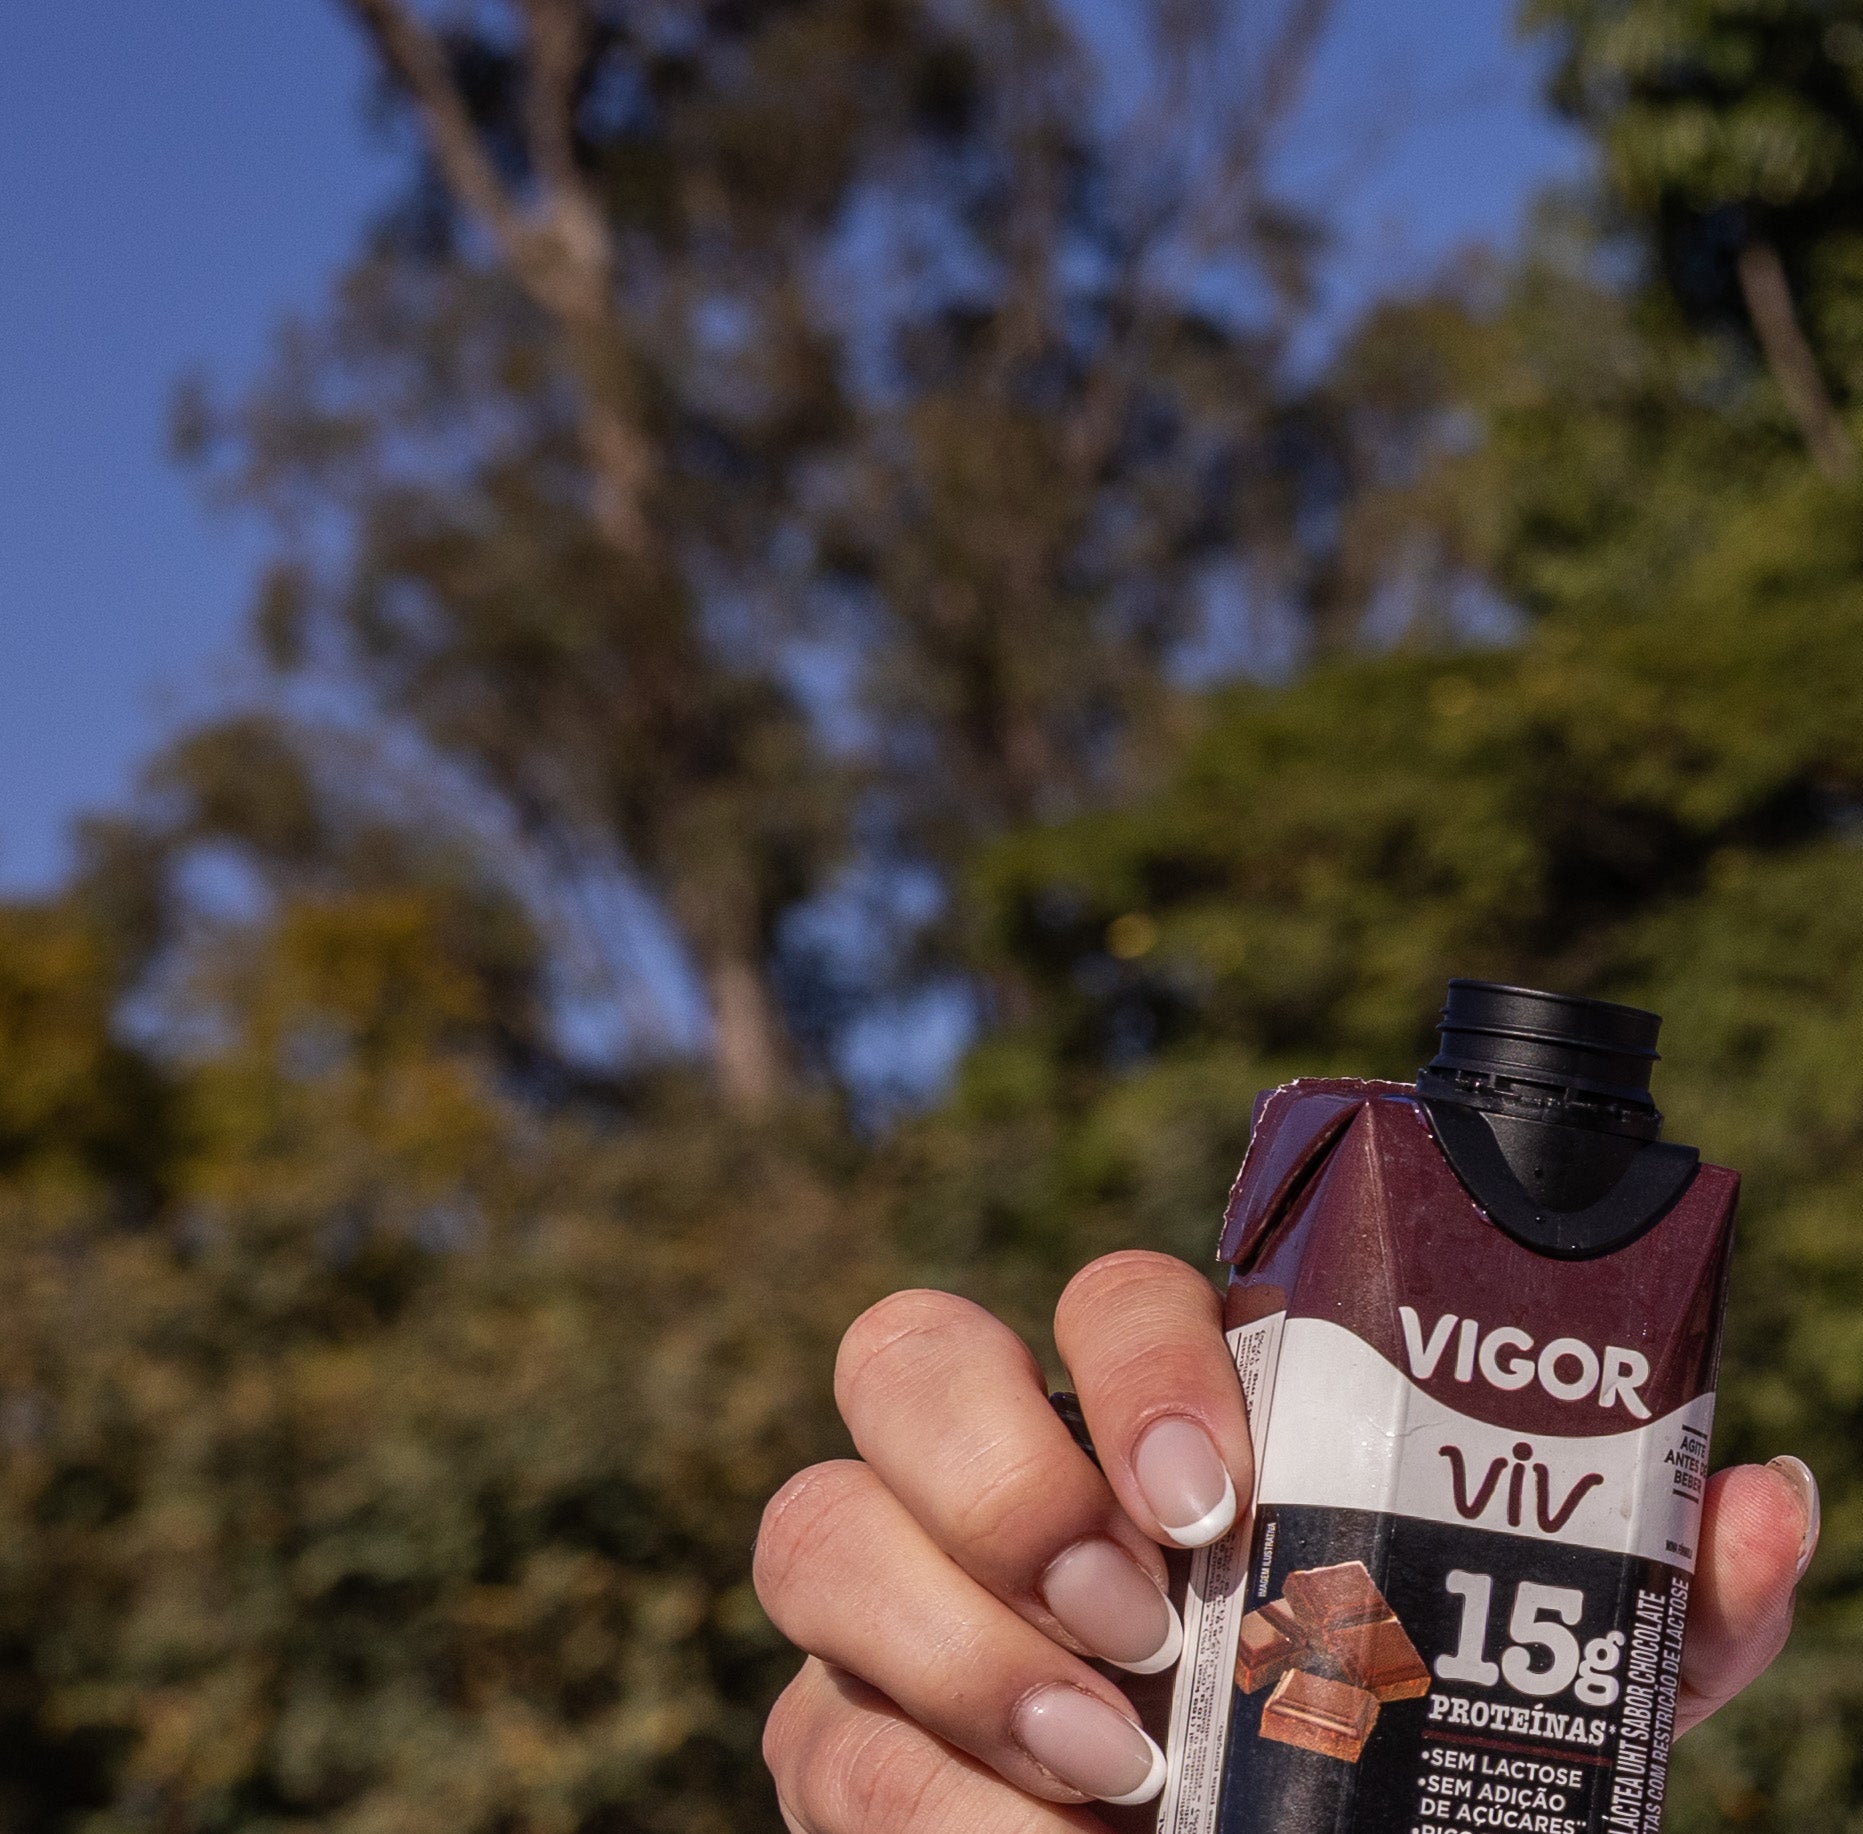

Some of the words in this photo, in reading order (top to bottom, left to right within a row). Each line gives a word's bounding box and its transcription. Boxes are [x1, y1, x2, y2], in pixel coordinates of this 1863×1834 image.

[1398, 1306, 1652, 1419] VIGOR
[1664, 1449, 1699, 1473] ANTES
[1674, 1470, 1702, 1494] BEBER
[1665, 1577, 1689, 1650] LACTOSE
[1435, 1569, 1625, 1706] 15g
[1628, 1590, 1666, 1683] CHOCOLATE
[1663, 1650, 1681, 1674] DE
[1620, 1684, 1654, 1741] SABOR
[1652, 1673, 1677, 1763] RESTRIÇÃO
[1481, 1756, 1583, 1788] LACTOSE
[1616, 1739, 1648, 1775] UHT
[1477, 1783, 1566, 1811] ADIÇÃO
[1648, 1764, 1667, 1801] COM
[1420, 1798, 1451, 1818] DE
